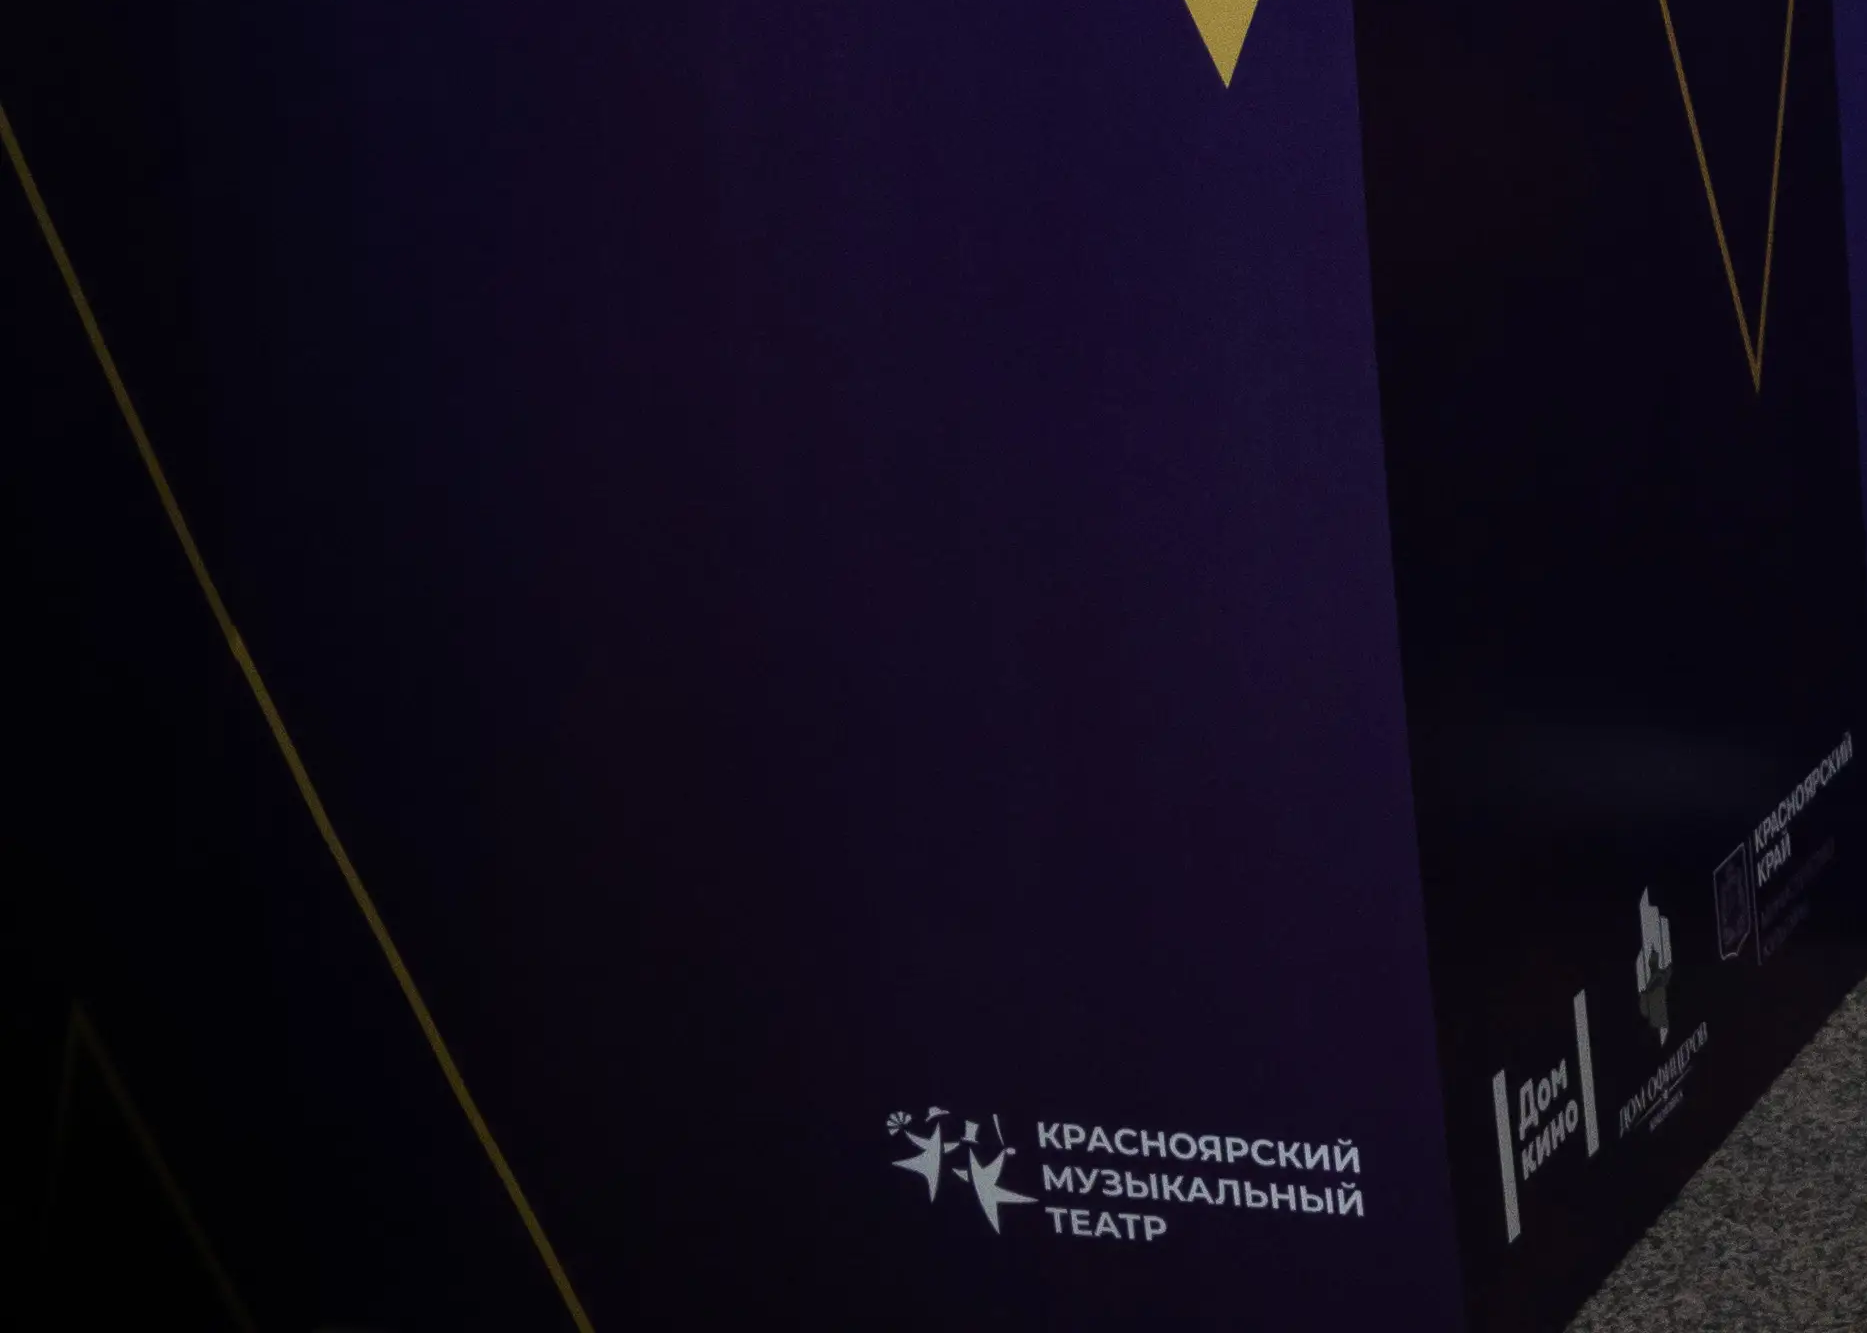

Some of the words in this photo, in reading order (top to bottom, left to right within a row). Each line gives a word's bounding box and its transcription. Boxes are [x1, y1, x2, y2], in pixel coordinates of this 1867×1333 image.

[1752, 728, 1854, 854] КРАСНОЯРСКИЙ
[1757, 830, 1792, 887] КРАЙ
[1036, 1121, 1361, 1174] КРАСНОЯРСКИЙ
[1041, 1165, 1365, 1217] МУЗЫКАЛЬНЫЙ
[1045, 1206, 1168, 1242] ТЕАТР
